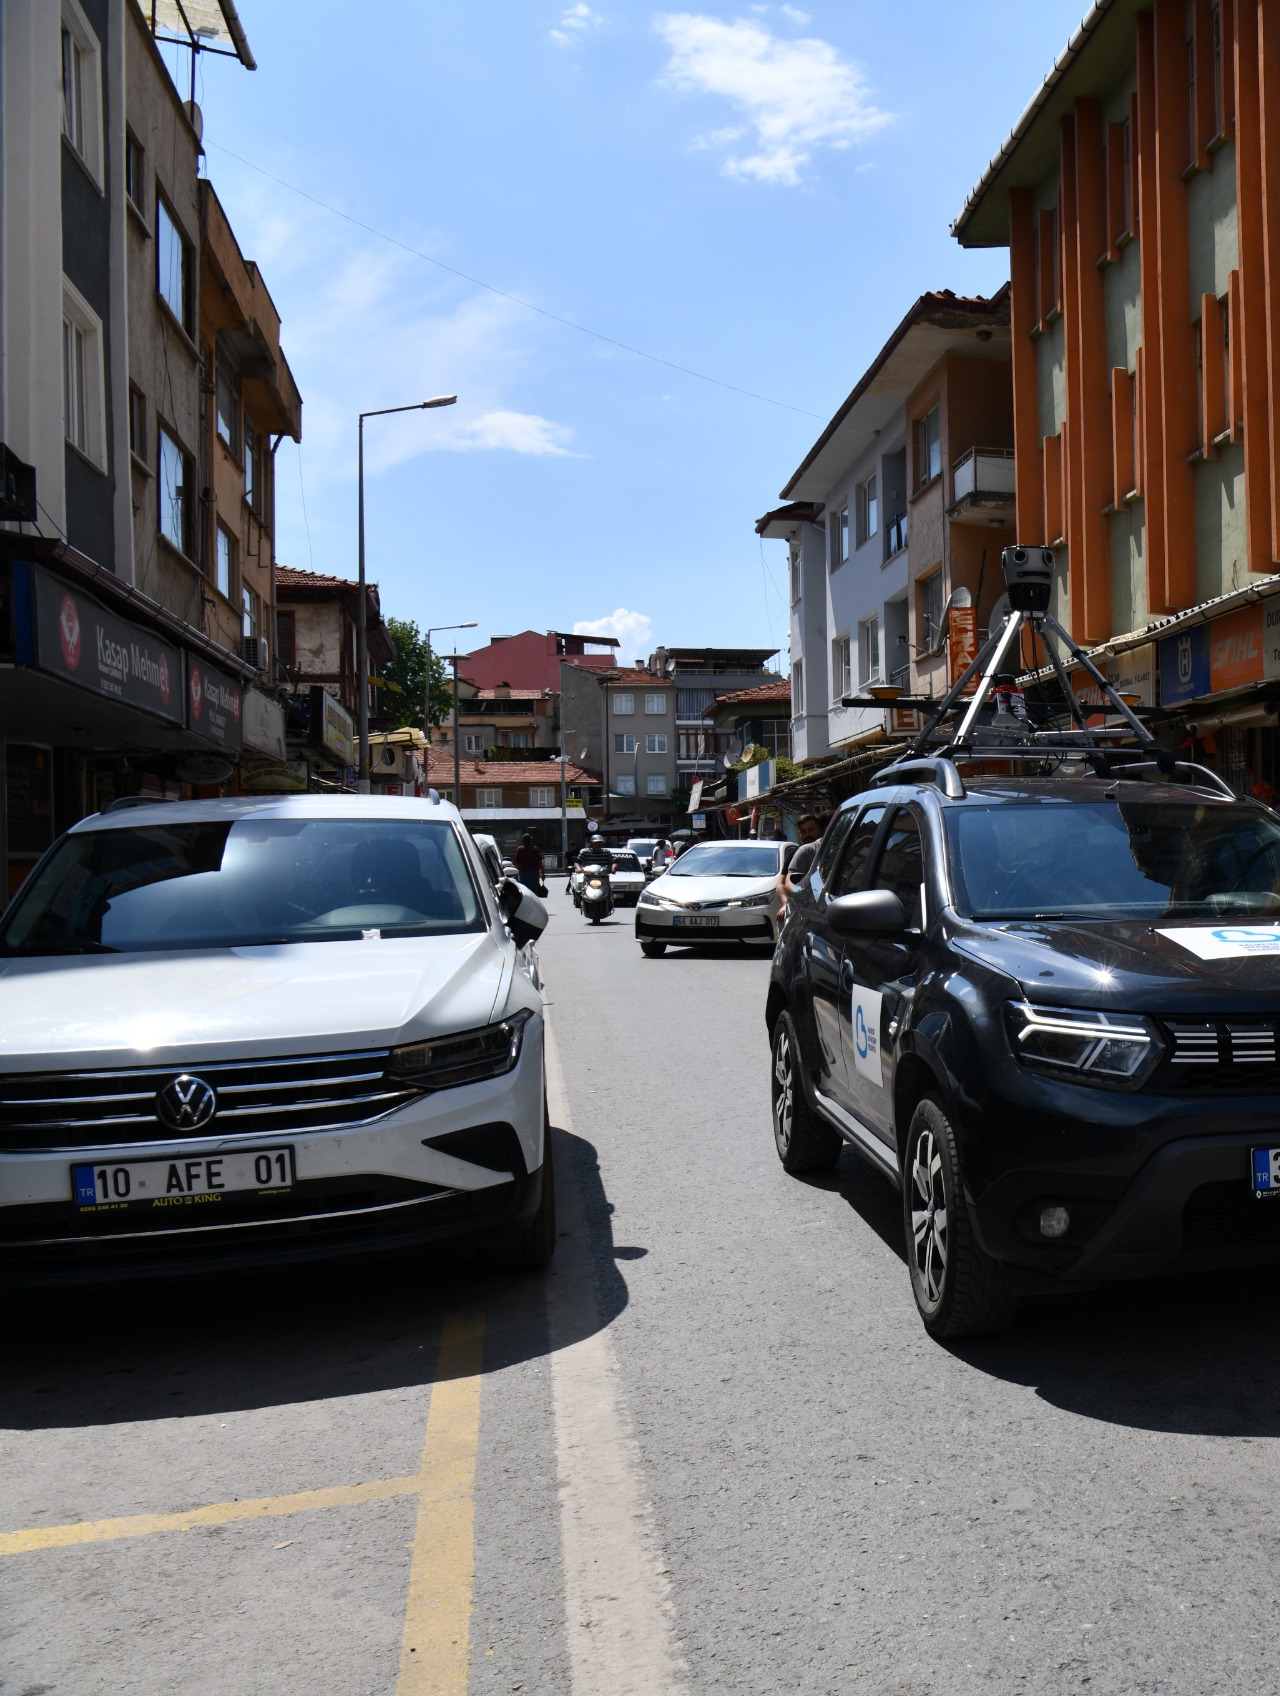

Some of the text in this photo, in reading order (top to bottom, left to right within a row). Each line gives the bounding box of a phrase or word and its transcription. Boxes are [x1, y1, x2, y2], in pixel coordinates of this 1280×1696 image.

[96, 624, 169, 694] Kasap Mehmet
[1213, 630, 1258, 670] STIHL
[204, 674, 219, 710] Kasap
[690, 917, 702, 925] AAJ
[706, 917, 717, 925] 013
[97, 1152, 287, 1199] 10 AFE 01
[1256, 1172, 1269, 1182] TR
[80, 1187, 94, 1197] TR
[152, 1192, 222, 1208] AUTO KING
